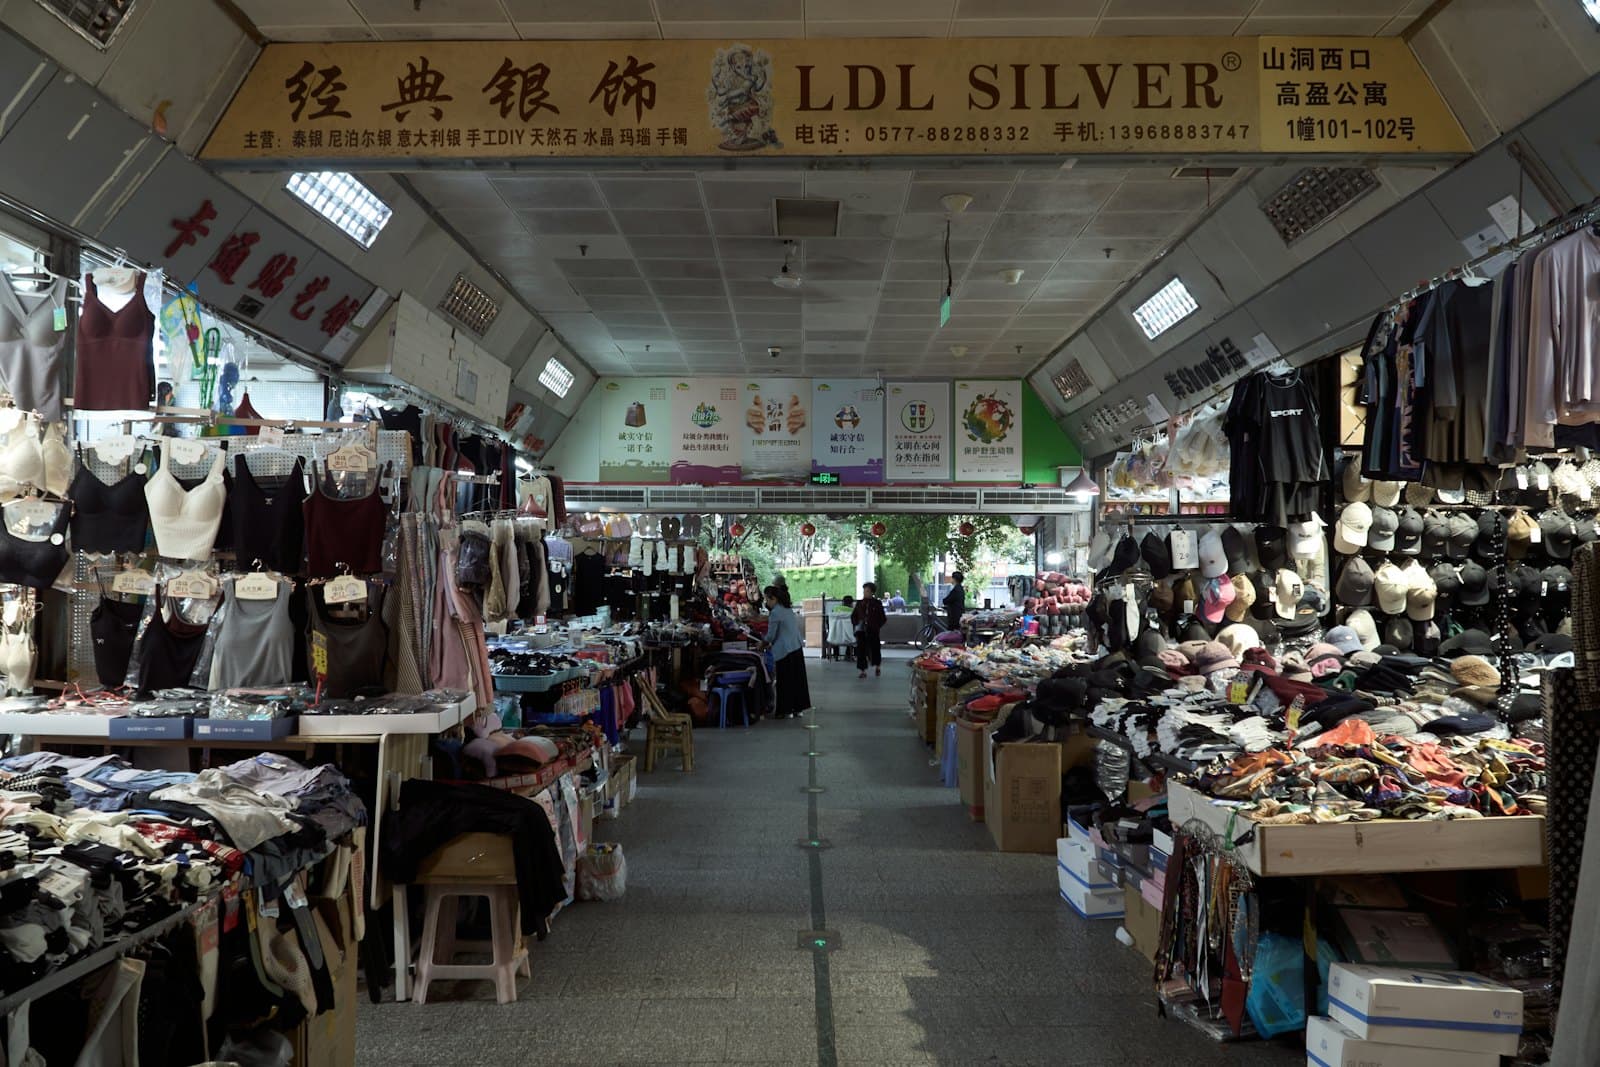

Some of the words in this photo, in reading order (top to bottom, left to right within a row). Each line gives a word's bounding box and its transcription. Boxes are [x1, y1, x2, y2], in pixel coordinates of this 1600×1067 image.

[1263, 46, 1371, 71] 山洞西口
[284, 55, 658, 124] 经典银饰
[795, 64, 934, 111] LDL
[968, 61, 1224, 111] SILVER
[1276, 81, 1388, 107] 高盈公寓
[864, 125, 1030, 143] 0577-88288332
[1286, 116, 1416, 142] 1幢101-102号
